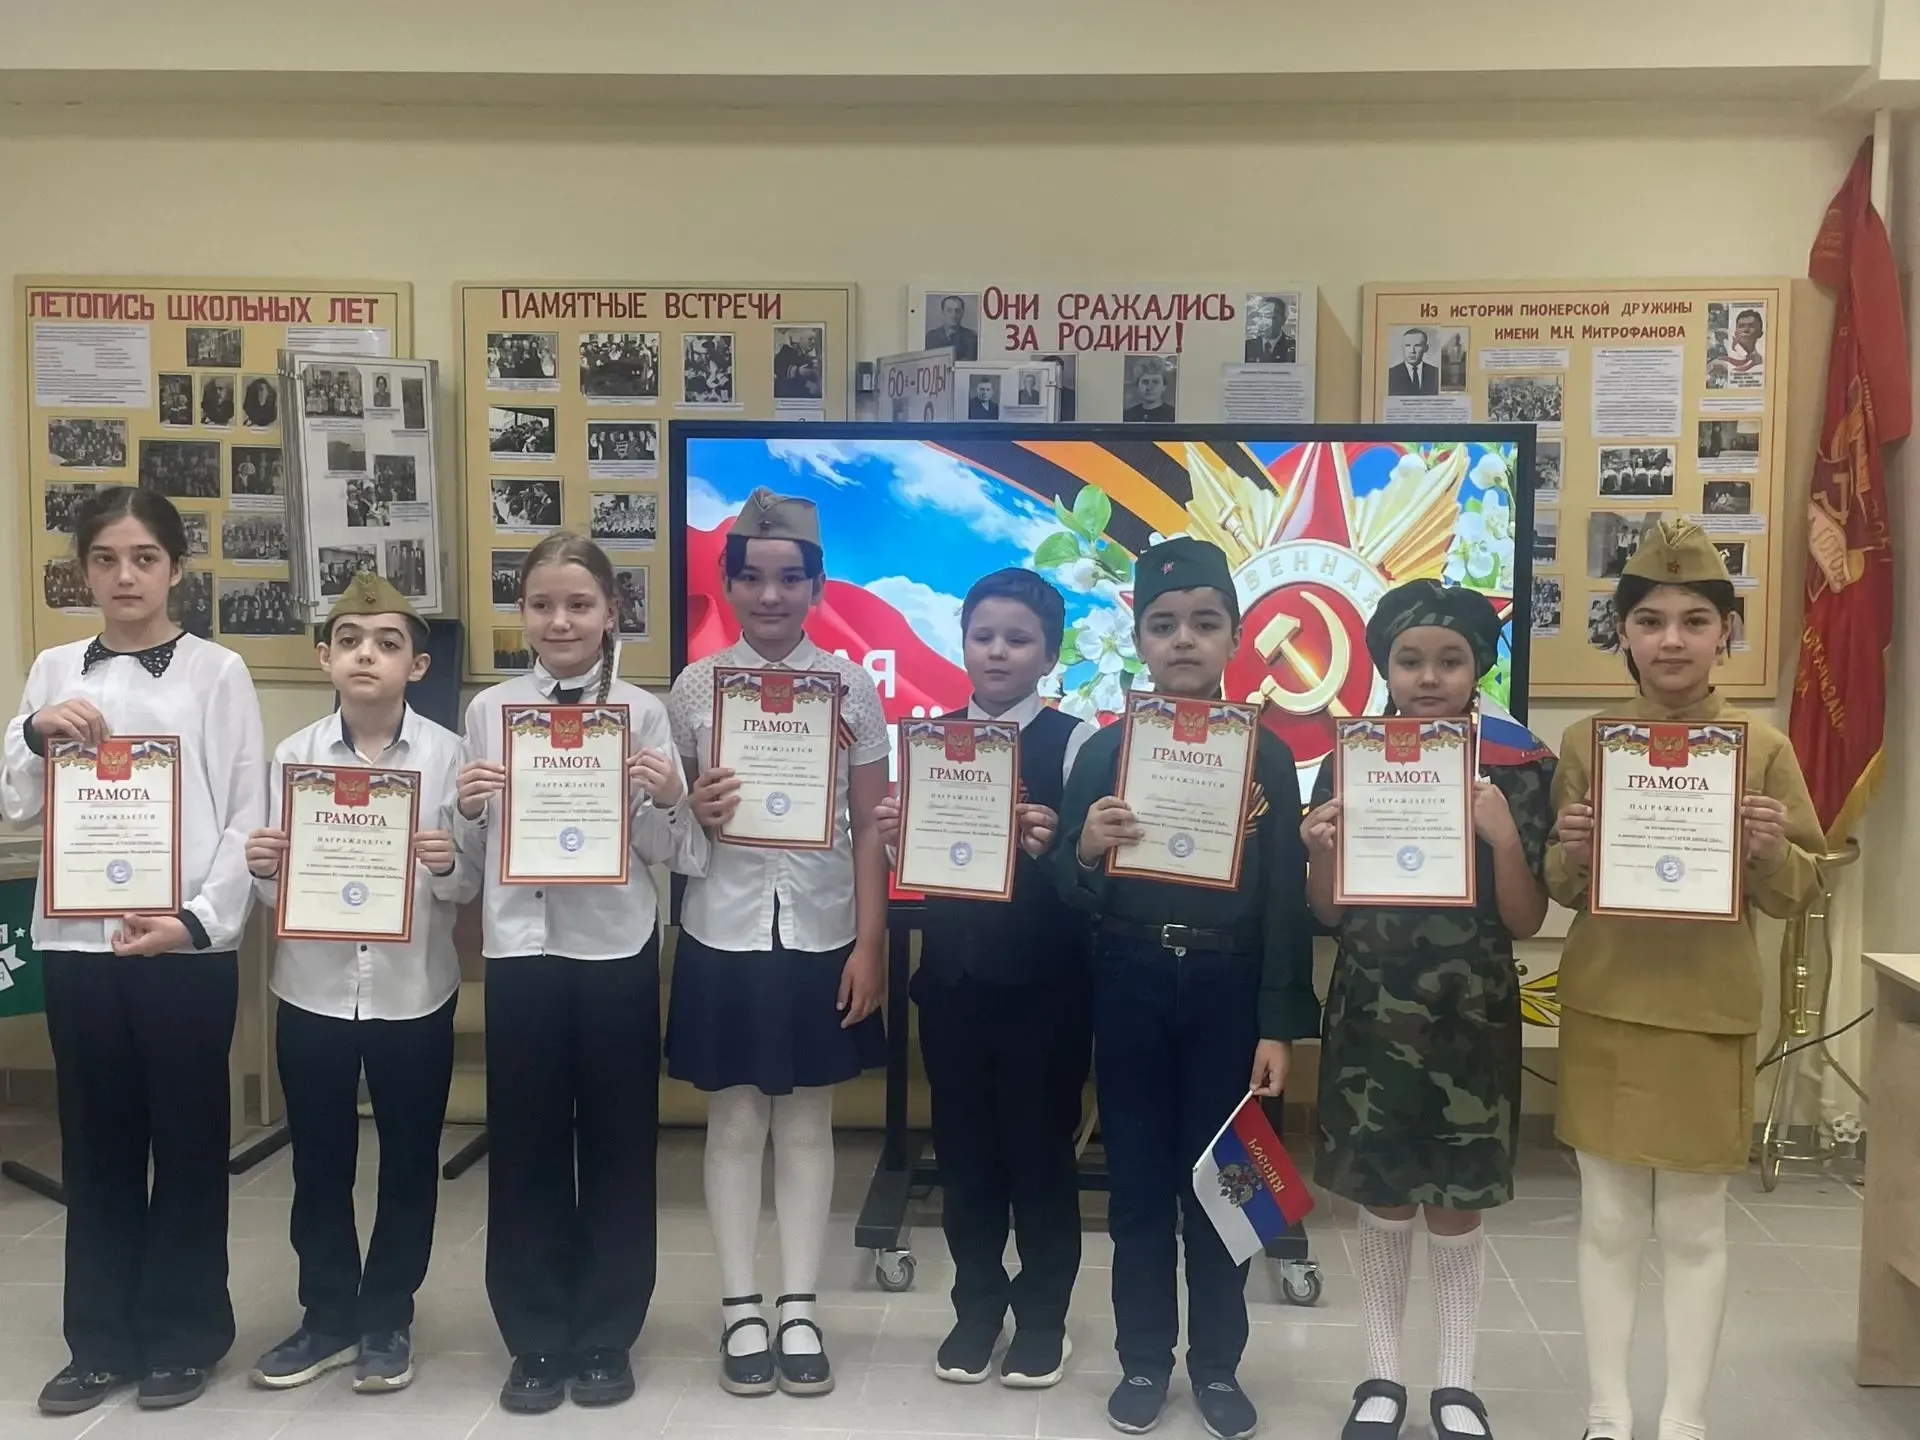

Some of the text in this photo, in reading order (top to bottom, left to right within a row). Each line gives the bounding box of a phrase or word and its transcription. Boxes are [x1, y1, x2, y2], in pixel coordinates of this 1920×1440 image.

[29, 291, 379, 324] ЛЕТОПИСЬ ШКОЛЬНЫХ ЛЕТ
[501, 289, 782, 320] ПАМЯТНЫЕ ВСТРЕЧИ
[983, 286, 1236, 321] ОНИ СРАЖАЛИСЬ
[1420, 301, 1692, 318] ИЗ ИСТОРИИ ПИОНЕРСКОЙ ДРУЖИНЫ
[1005, 321, 1184, 353] ЗА РОДИНУ!
[1494, 327, 1540, 340] ИМЕНИ
[1582, 325, 1686, 340] МИТРОФАНОВА
[743, 719, 810, 734] ГРАМОТА
[533, 756, 602, 769] ГРАМОТА
[1152, 747, 1223, 767] ГРАМОТА
[929, 767, 992, 783] ГРАМОТА
[1367, 770, 1441, 784] ГРАМОТА
[1628, 774, 1710, 791] ГРАМОТА
[78, 788, 150, 801] ГРАМОТА
[315, 811, 387, 827] ГРАМОТА
